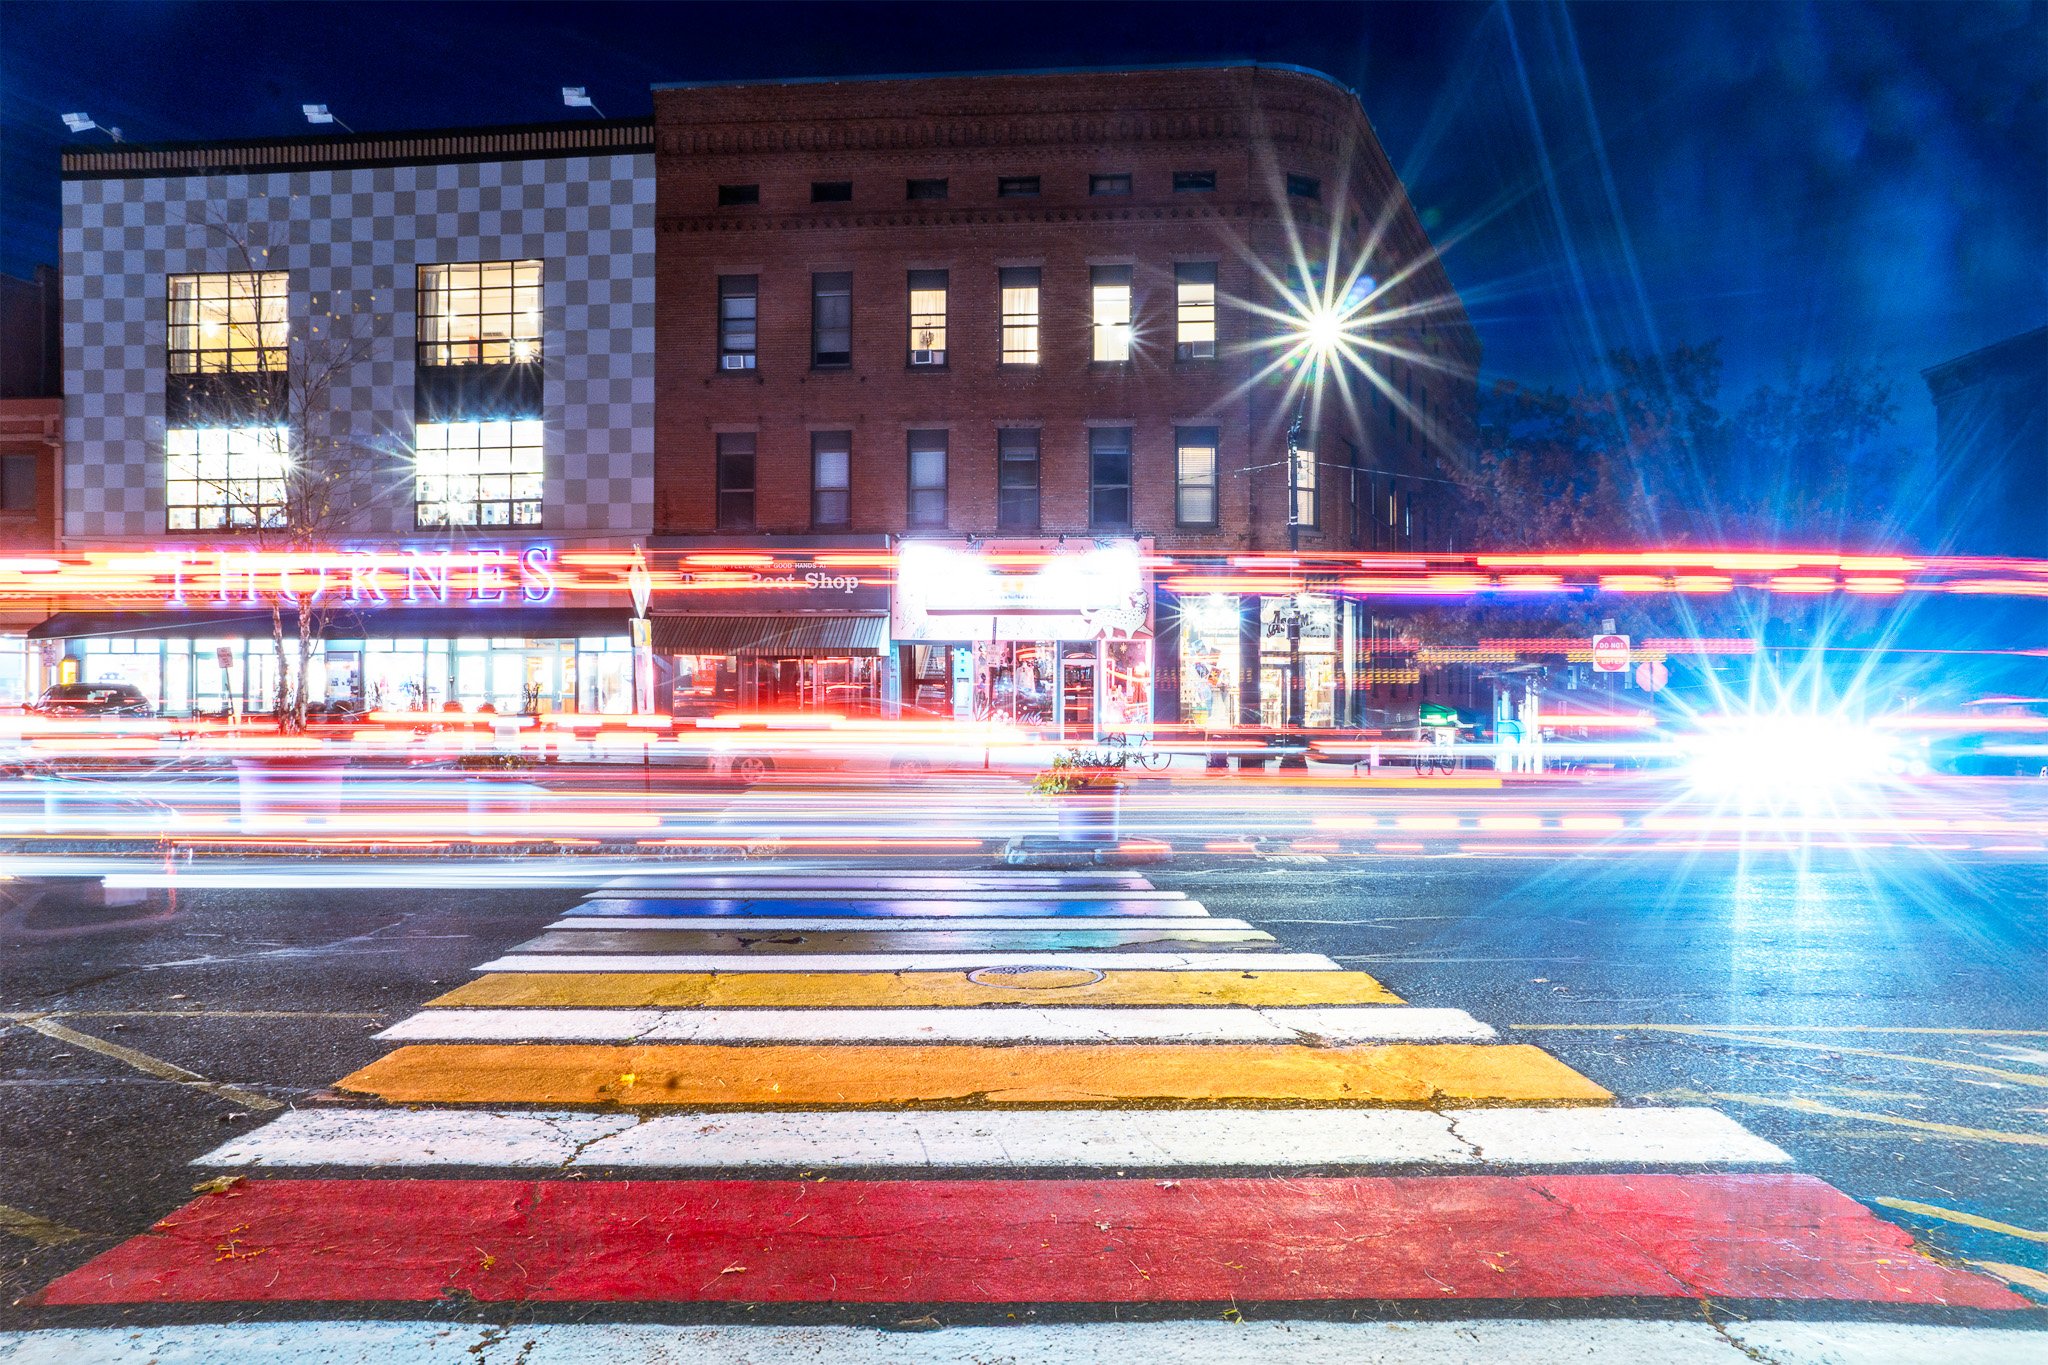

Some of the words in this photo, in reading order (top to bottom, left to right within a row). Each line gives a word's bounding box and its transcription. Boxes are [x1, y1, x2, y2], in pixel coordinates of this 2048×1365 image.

[156, 547, 554, 605] THORNES
[804, 572, 859, 594] Shop
[1601, 657, 1625, 665] ENTER
